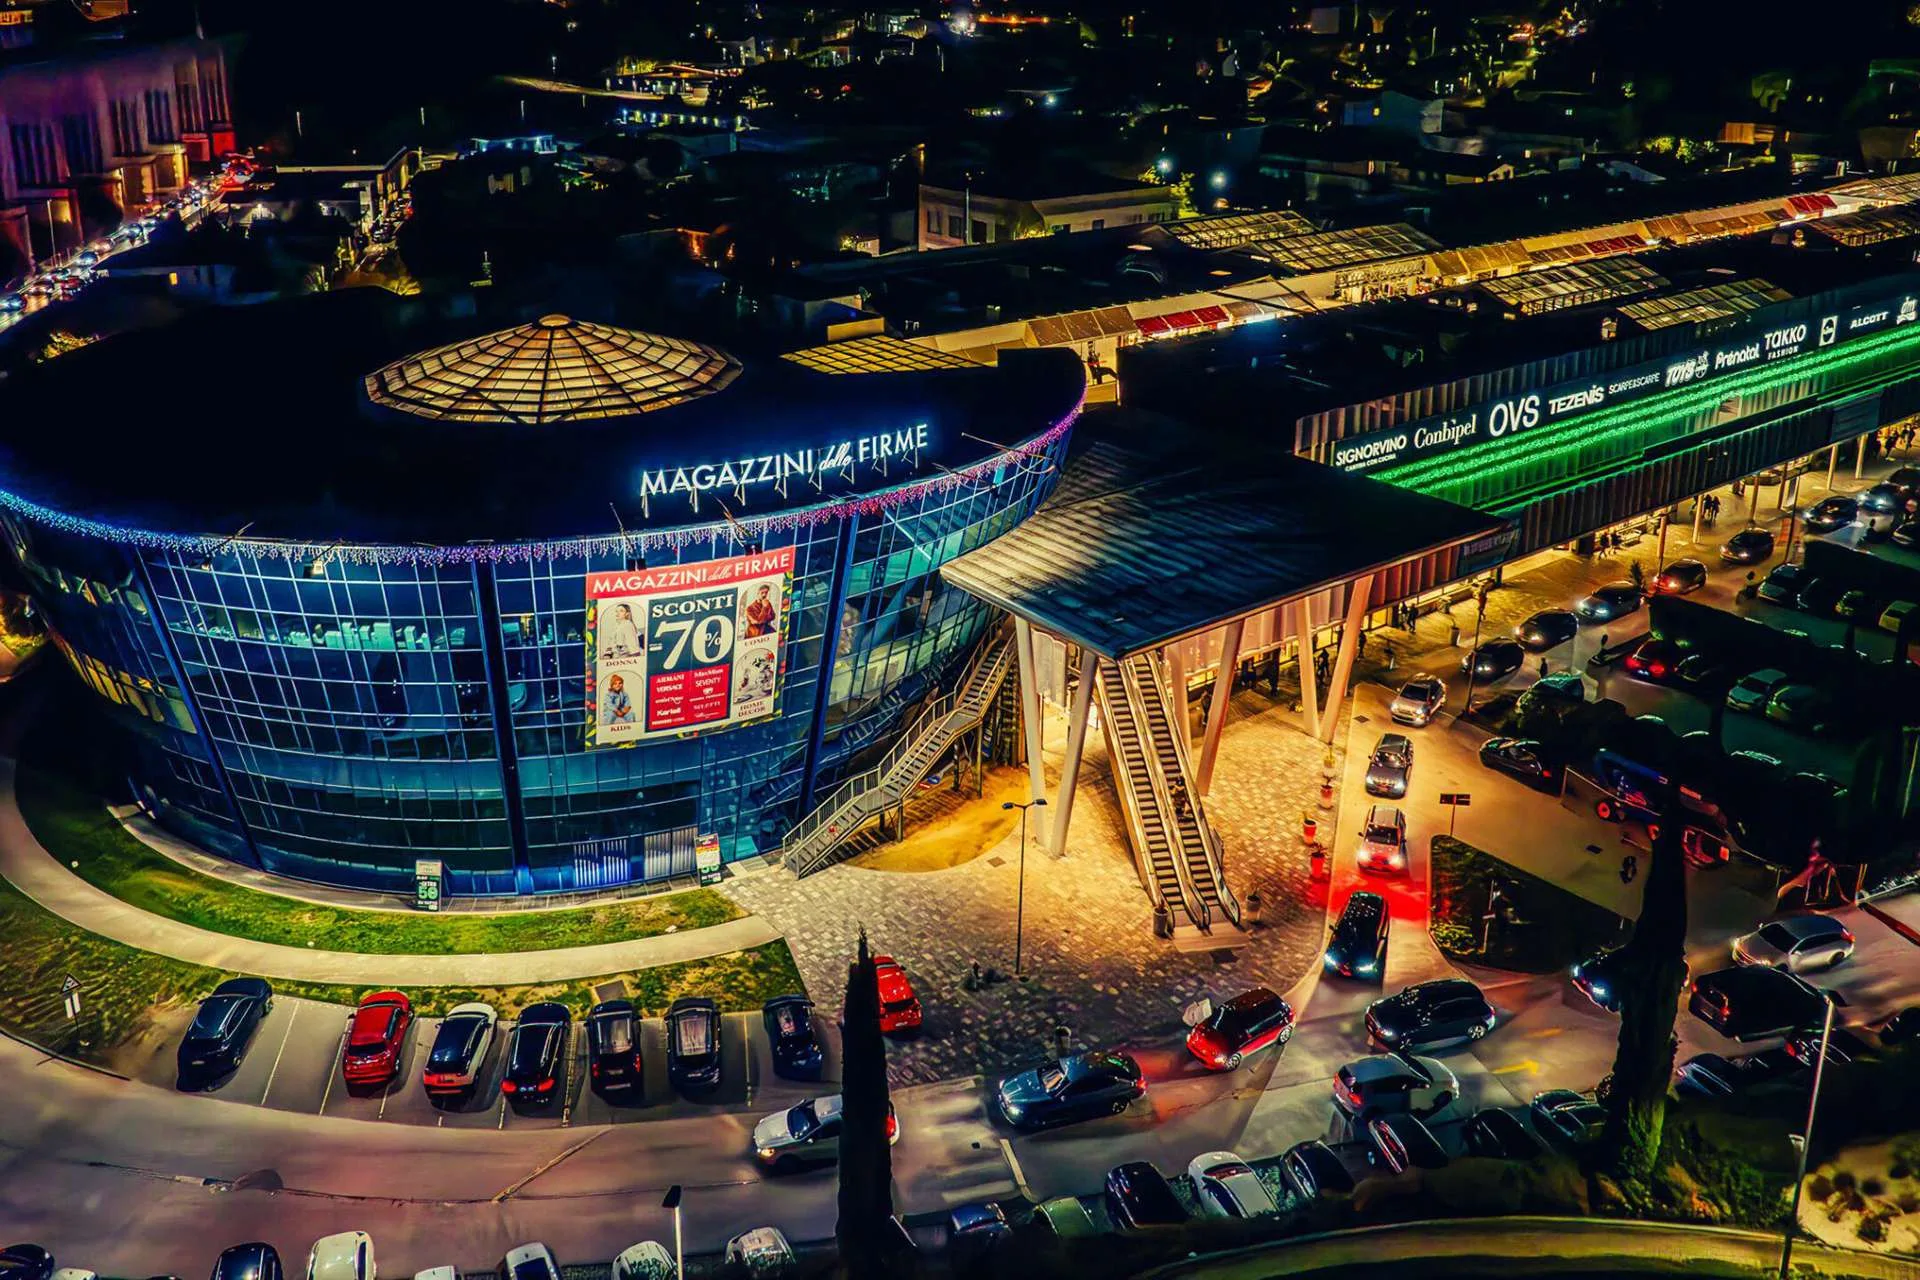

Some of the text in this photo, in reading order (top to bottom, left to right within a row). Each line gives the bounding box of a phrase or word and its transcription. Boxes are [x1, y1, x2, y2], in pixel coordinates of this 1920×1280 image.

[1850, 311, 1889, 329] ALCOTT
[1764, 324, 1807, 350] TAKKO
[1767, 345, 1799, 360] FASHION
[1665, 358, 1697, 387] TOYS
[1549, 384, 1605, 415] TEZENIS
[1414, 414, 1477, 449] Conbipel
[1489, 395, 1540, 437] OVS
[641, 449, 813, 497] MAGAZZINI
[860, 424, 928, 462] FIRME
[1335, 435, 1407, 466] SIGNORVINO
[593, 568, 707, 593] MAGAZZINI
[735, 553, 790, 577] FIRME
[652, 594, 734, 618] SCONTI
